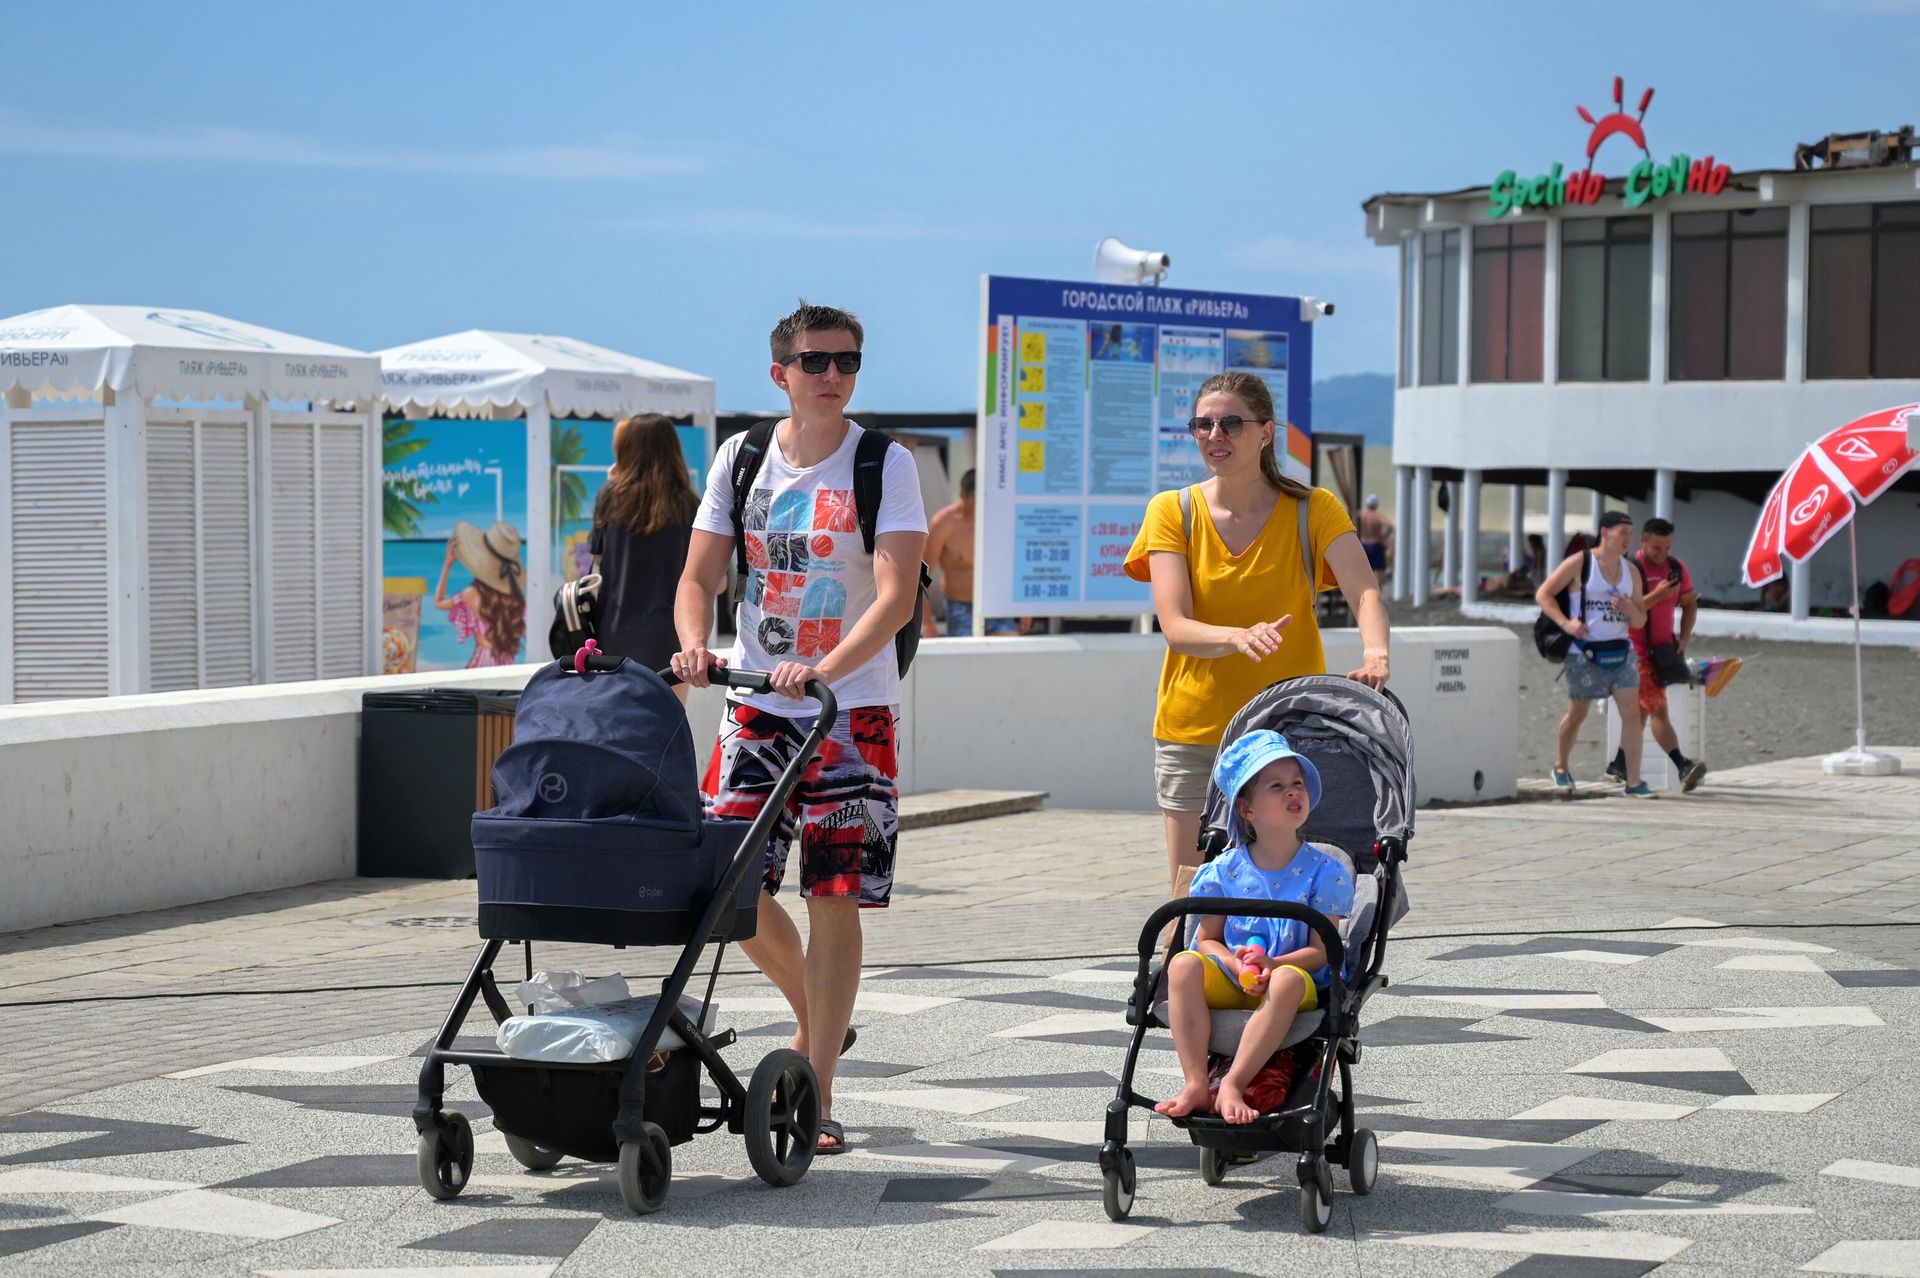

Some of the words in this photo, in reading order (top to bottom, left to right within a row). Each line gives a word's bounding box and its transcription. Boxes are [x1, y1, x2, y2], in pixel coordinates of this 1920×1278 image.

[1062, 290, 1143, 312] ГОРОДСКОЙ
[1147, 296, 1183, 315] ПЛЯЖ
[1186, 299, 1249, 319] «РИВЬЕРА»
[0, 352, 69, 367] ИВЬЕРА»
[179, 360, 203, 375] ПЛЯЖ
[736, 467, 746, 486] THULE
